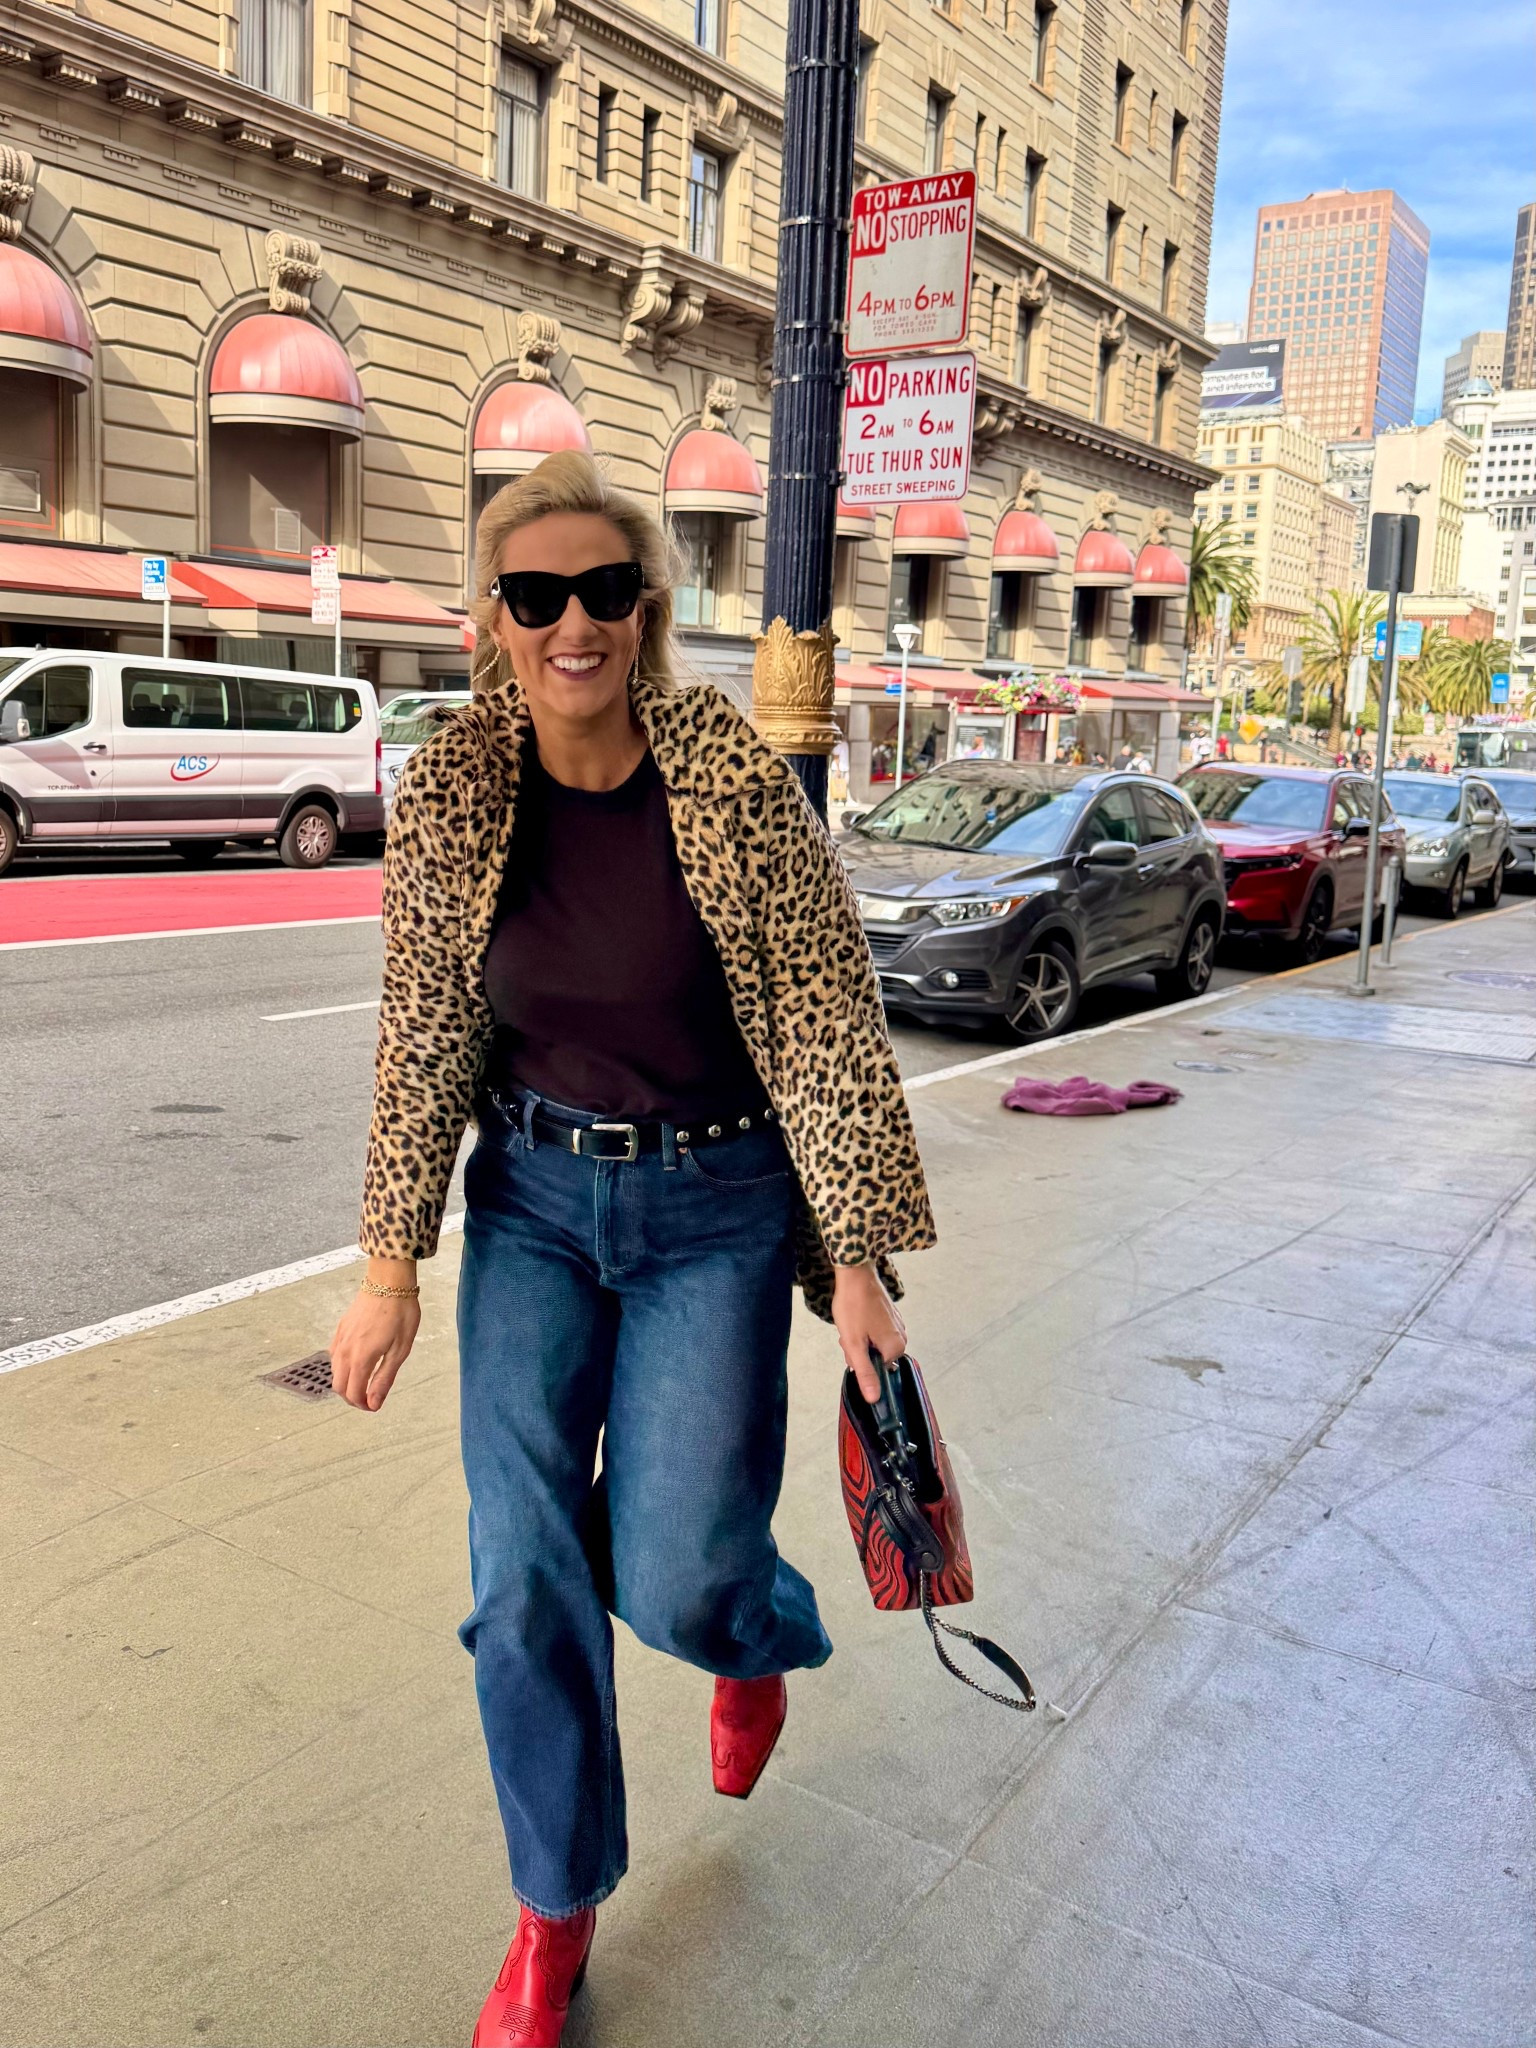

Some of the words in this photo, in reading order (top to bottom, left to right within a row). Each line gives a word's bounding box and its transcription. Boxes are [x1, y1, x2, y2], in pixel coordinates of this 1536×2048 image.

[864, 176, 964, 212] TOW-AWAY
[855, 210, 887, 251] NO
[889, 204, 967, 242] STOPPING
[899, 298, 912, 311] TO
[850, 365, 883, 403] NO
[888, 366, 971, 399] PARKING
[903, 418, 913, 428] TO
[848, 452, 875, 475] TUE
[882, 449, 924, 473] THUR
[930, 446, 963, 470] SUN
[851, 482, 892, 496] STREET
[896, 479, 956, 494] SWEEPING
[177, 756, 207, 771] ACS
